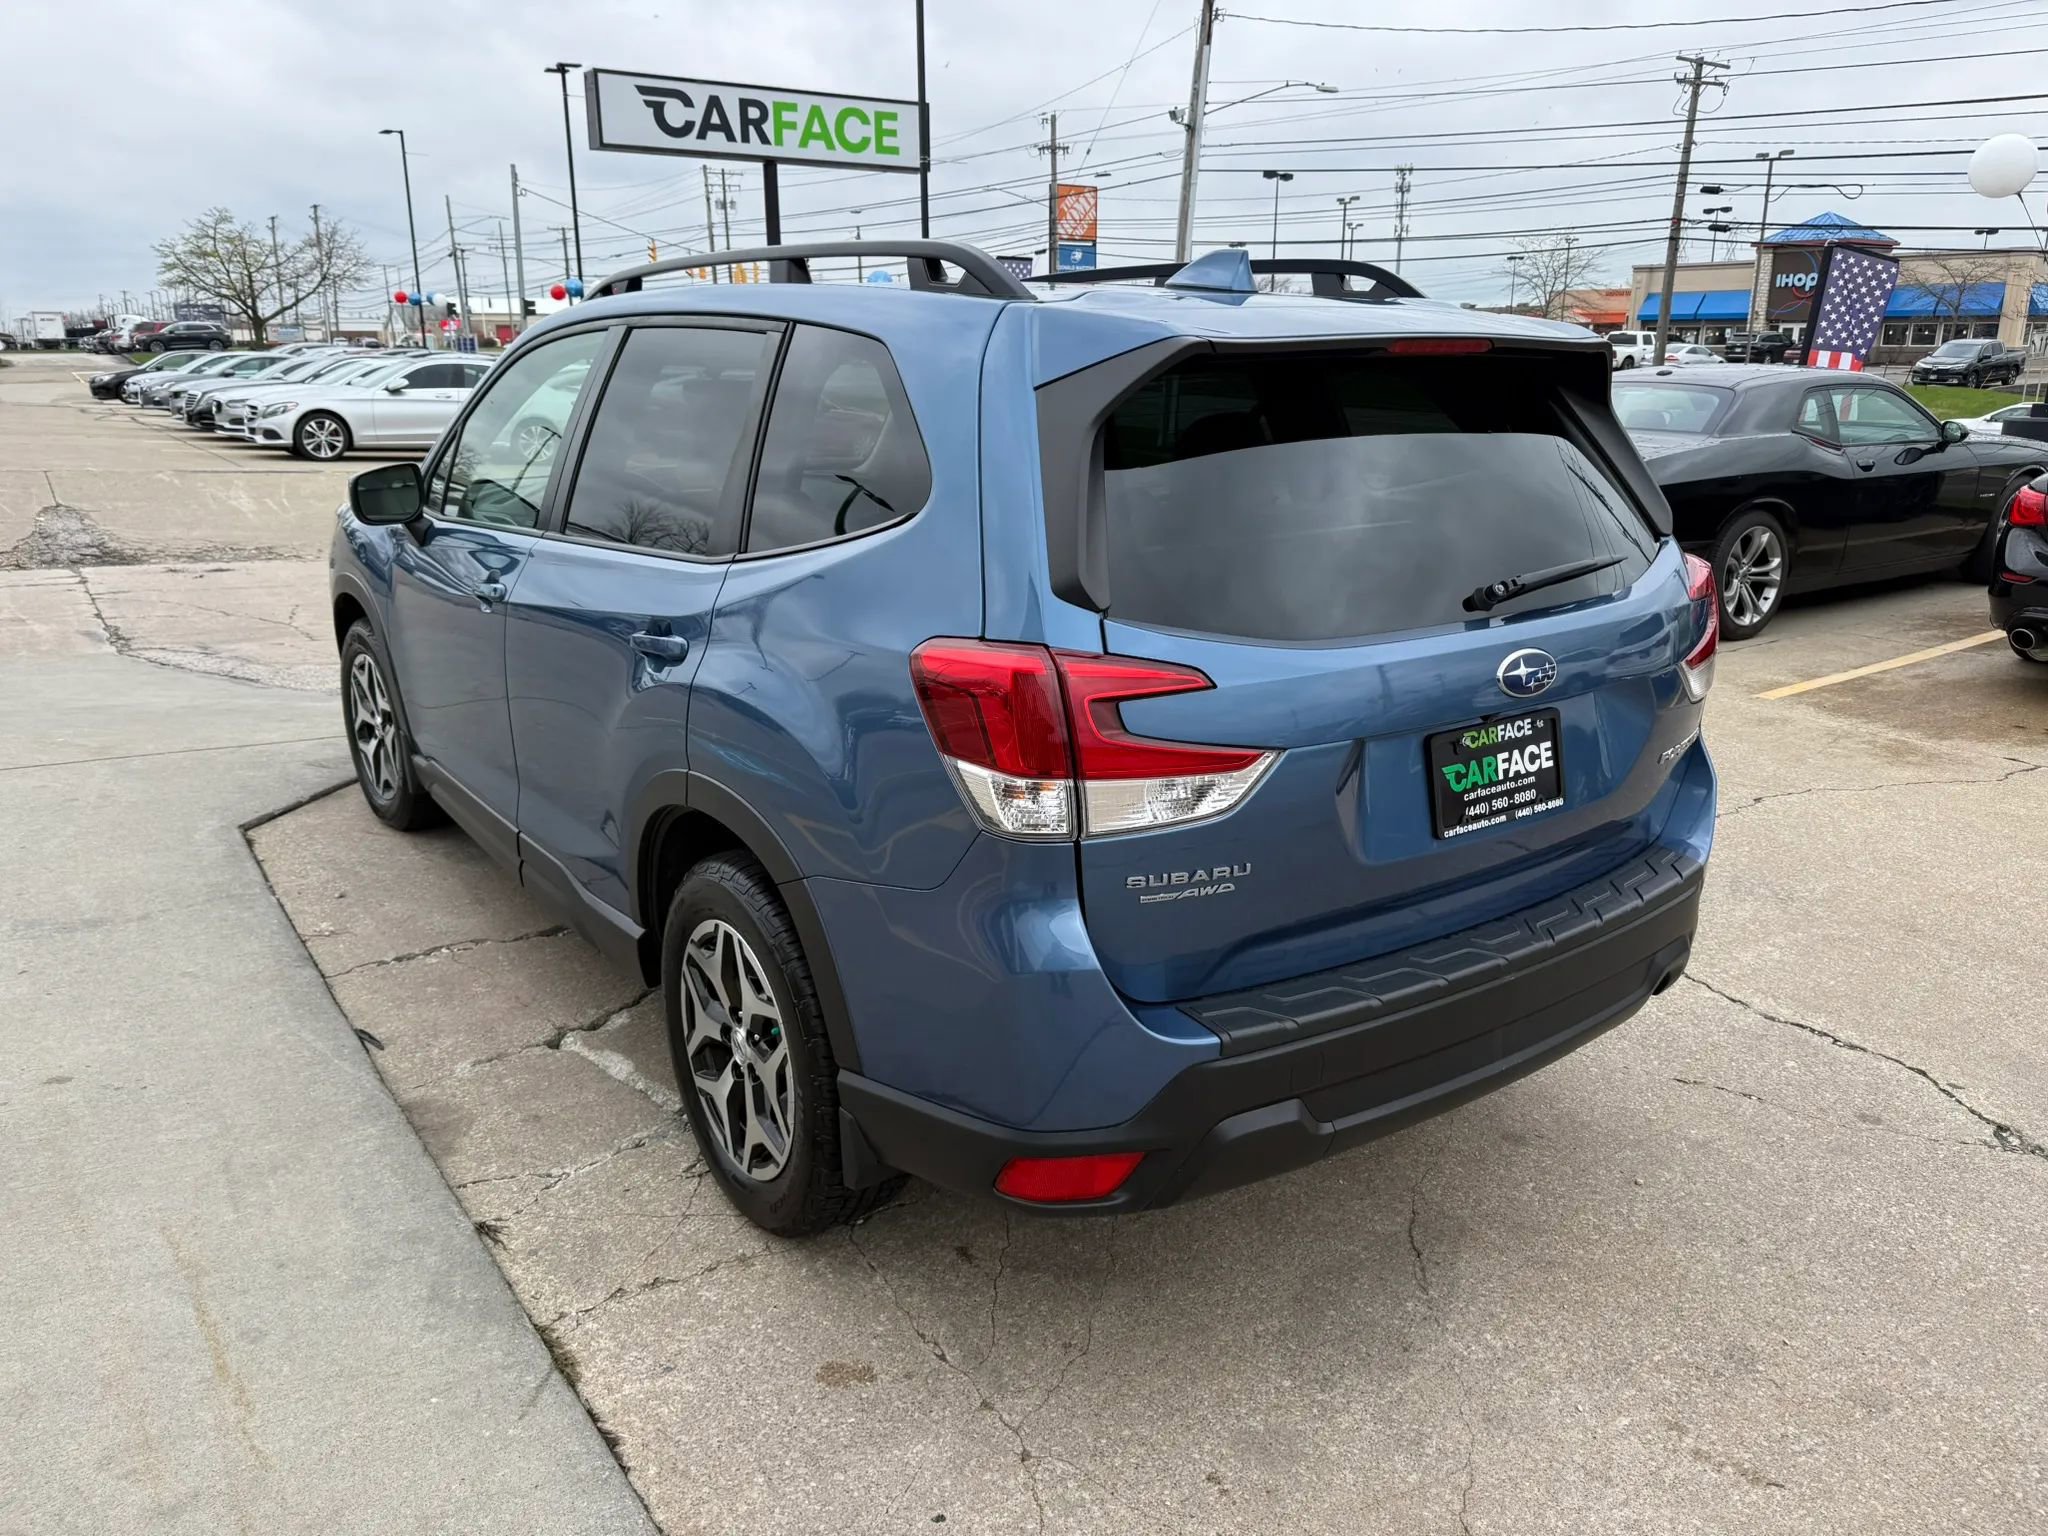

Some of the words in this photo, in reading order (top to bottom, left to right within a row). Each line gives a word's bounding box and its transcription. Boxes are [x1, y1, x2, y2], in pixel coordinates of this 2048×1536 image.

[634, 84, 900, 156] CARFACE
[1462, 718, 1533, 749] CARFACE
[1441, 741, 1554, 792] CARFACE
[1463, 776, 1536, 801] carfaceauto.com
[1444, 814, 1507, 838] carfaceauto.com
[1515, 806, 1533, 820] (440)
[1465, 802, 1489, 817] (440)
[1126, 862, 1252, 889] SUBARU
[1177, 883, 1236, 899] AWD
